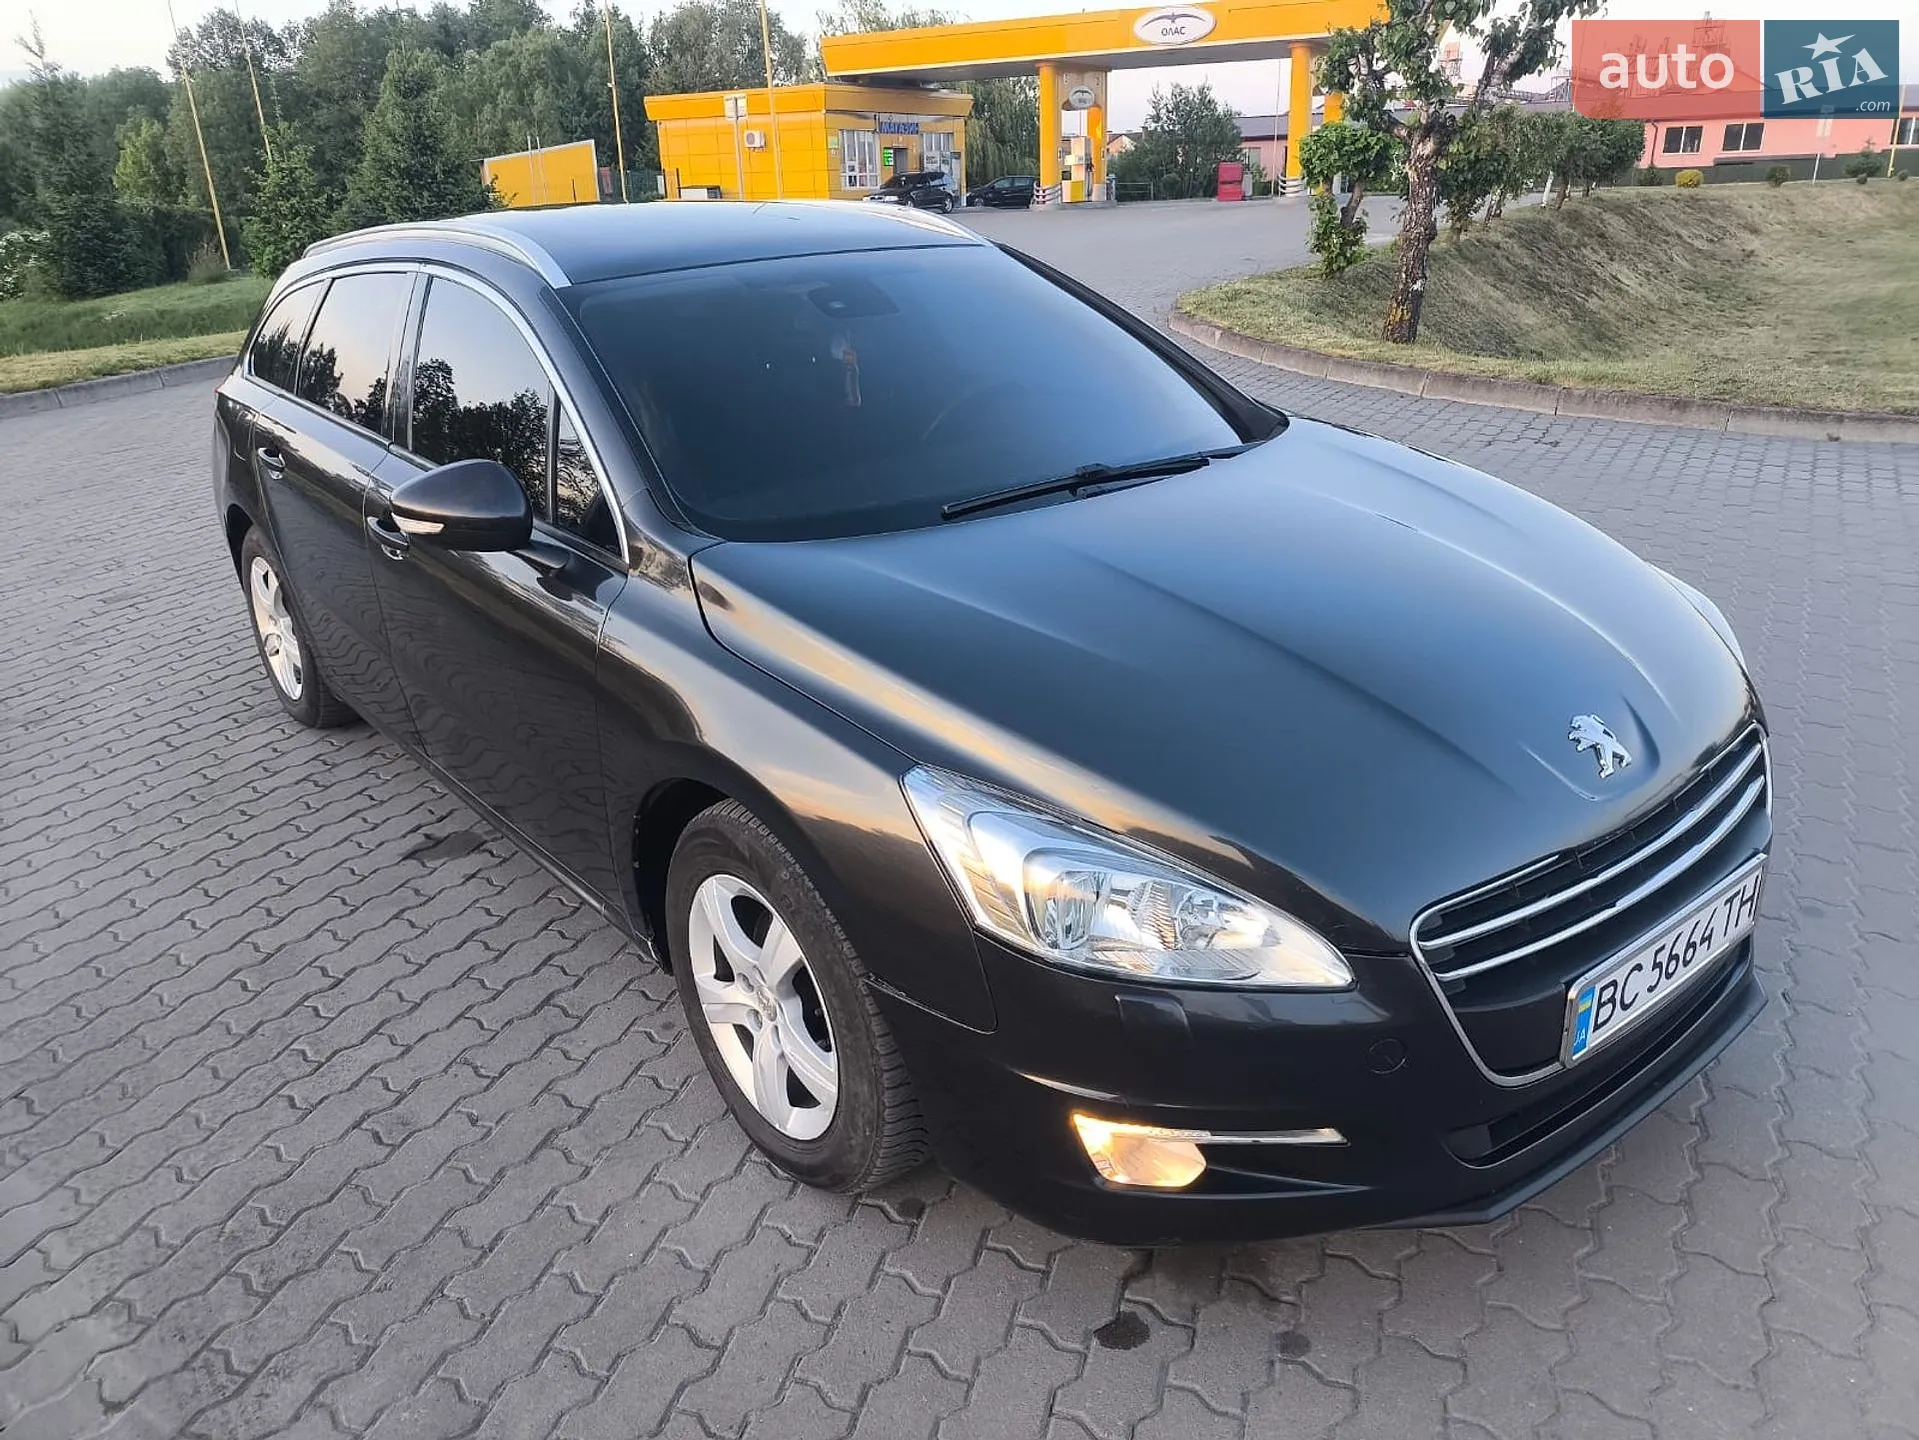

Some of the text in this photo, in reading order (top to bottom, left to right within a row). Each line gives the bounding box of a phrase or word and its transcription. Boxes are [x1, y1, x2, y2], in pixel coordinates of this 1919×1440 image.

[1161, 26, 1187, 36] ОЛАС
[1592, 875, 1760, 1033] BC 5664 TH
